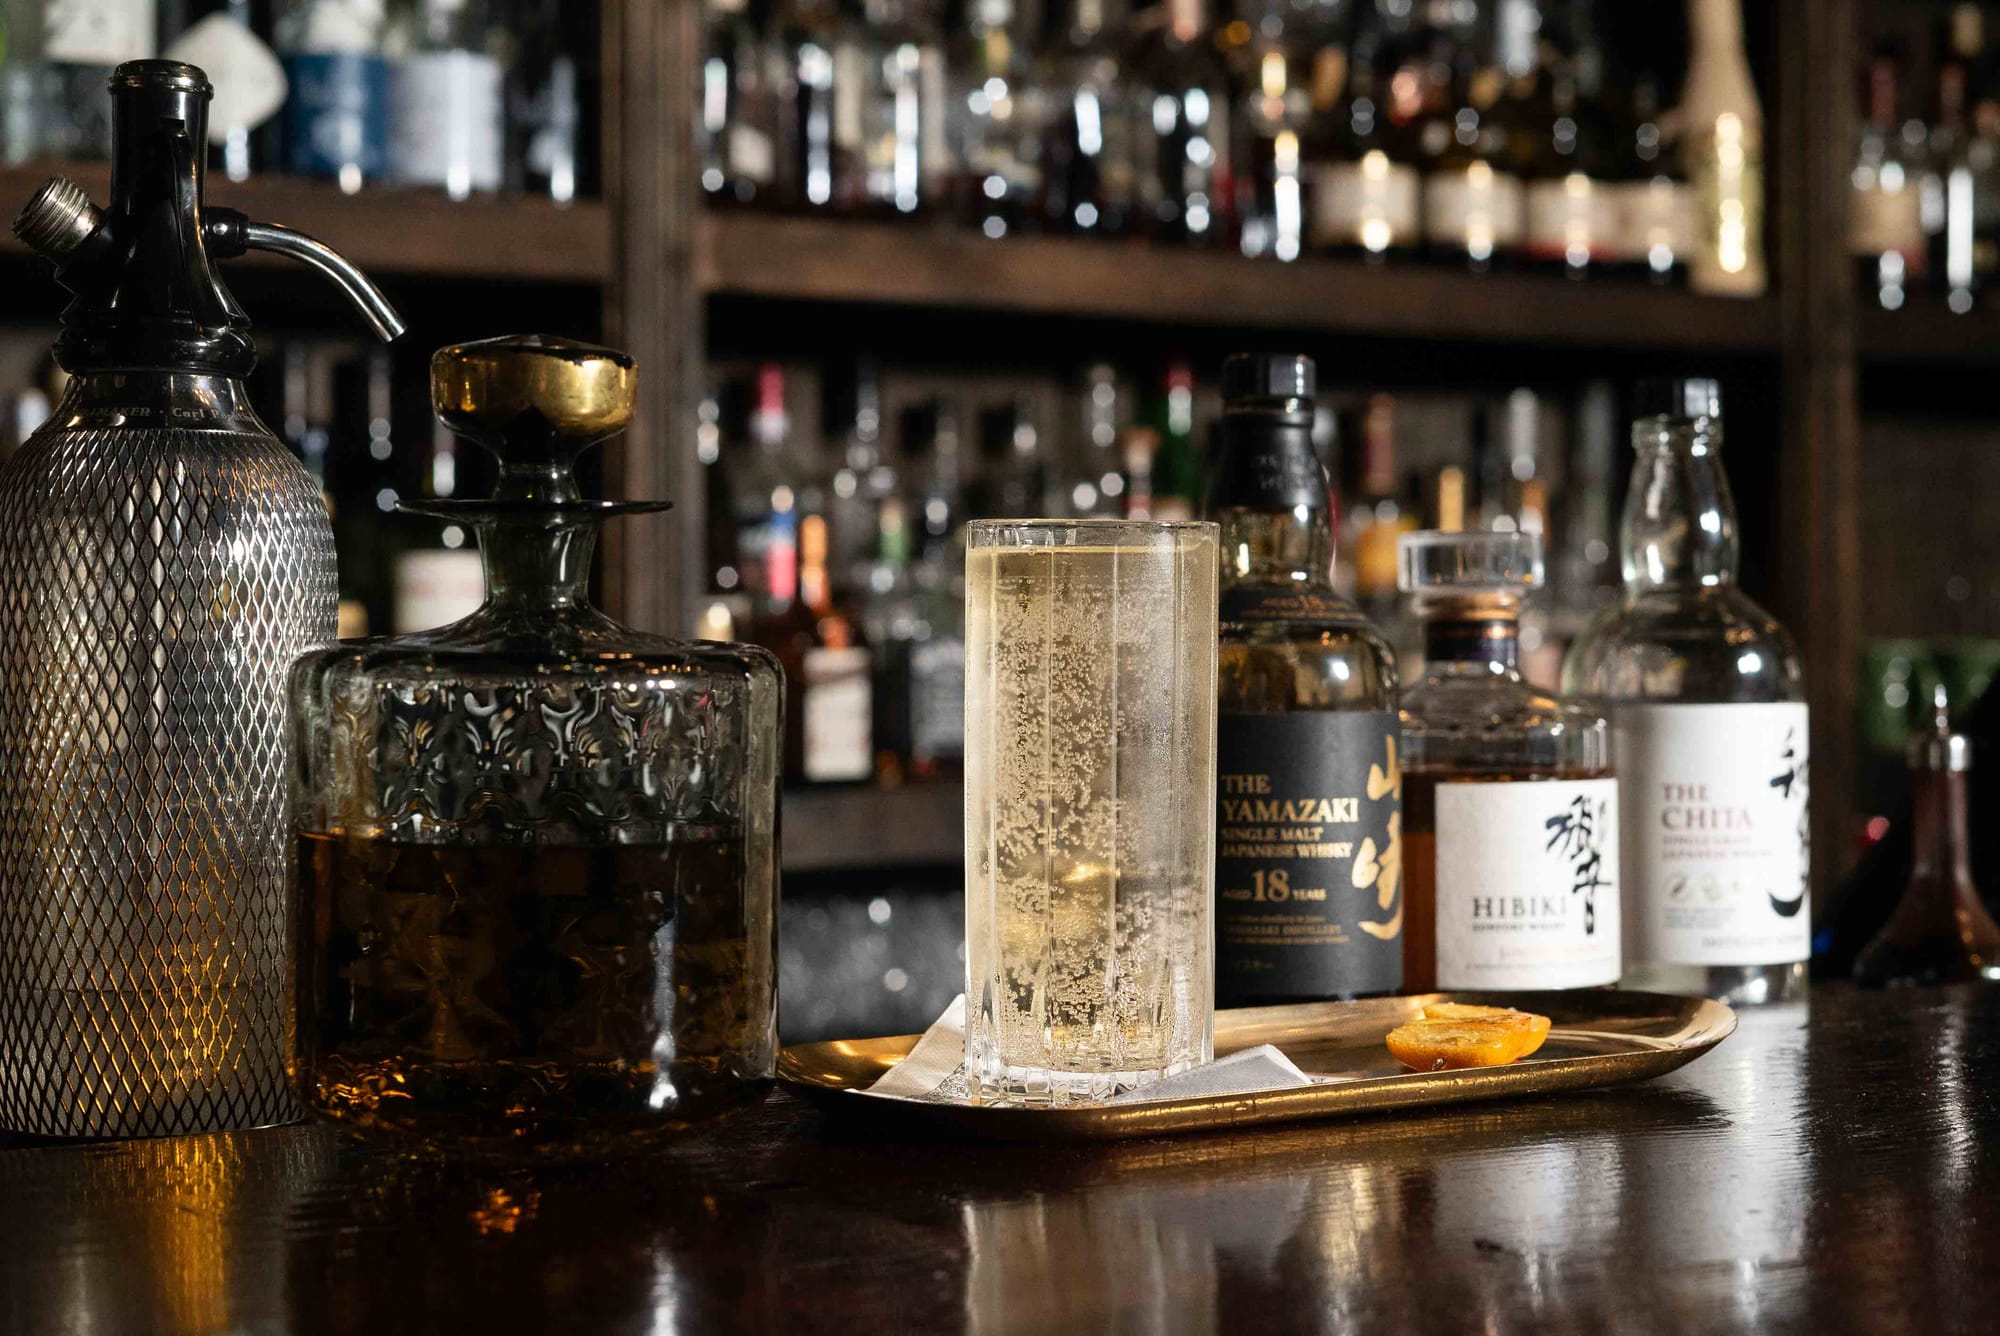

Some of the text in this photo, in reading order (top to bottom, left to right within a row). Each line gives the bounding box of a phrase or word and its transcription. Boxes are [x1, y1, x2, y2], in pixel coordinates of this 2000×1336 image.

[1221, 774, 1271, 794] THE
[1662, 784, 1707, 802] THE
[1221, 798, 1359, 822] YAMAZAKI
[1660, 806, 1752, 830] CHITA
[1221, 826, 1324, 841] SINGLE MALT
[1251, 869, 1291, 902] 18
[1471, 896, 1568, 918] HIBIKI
